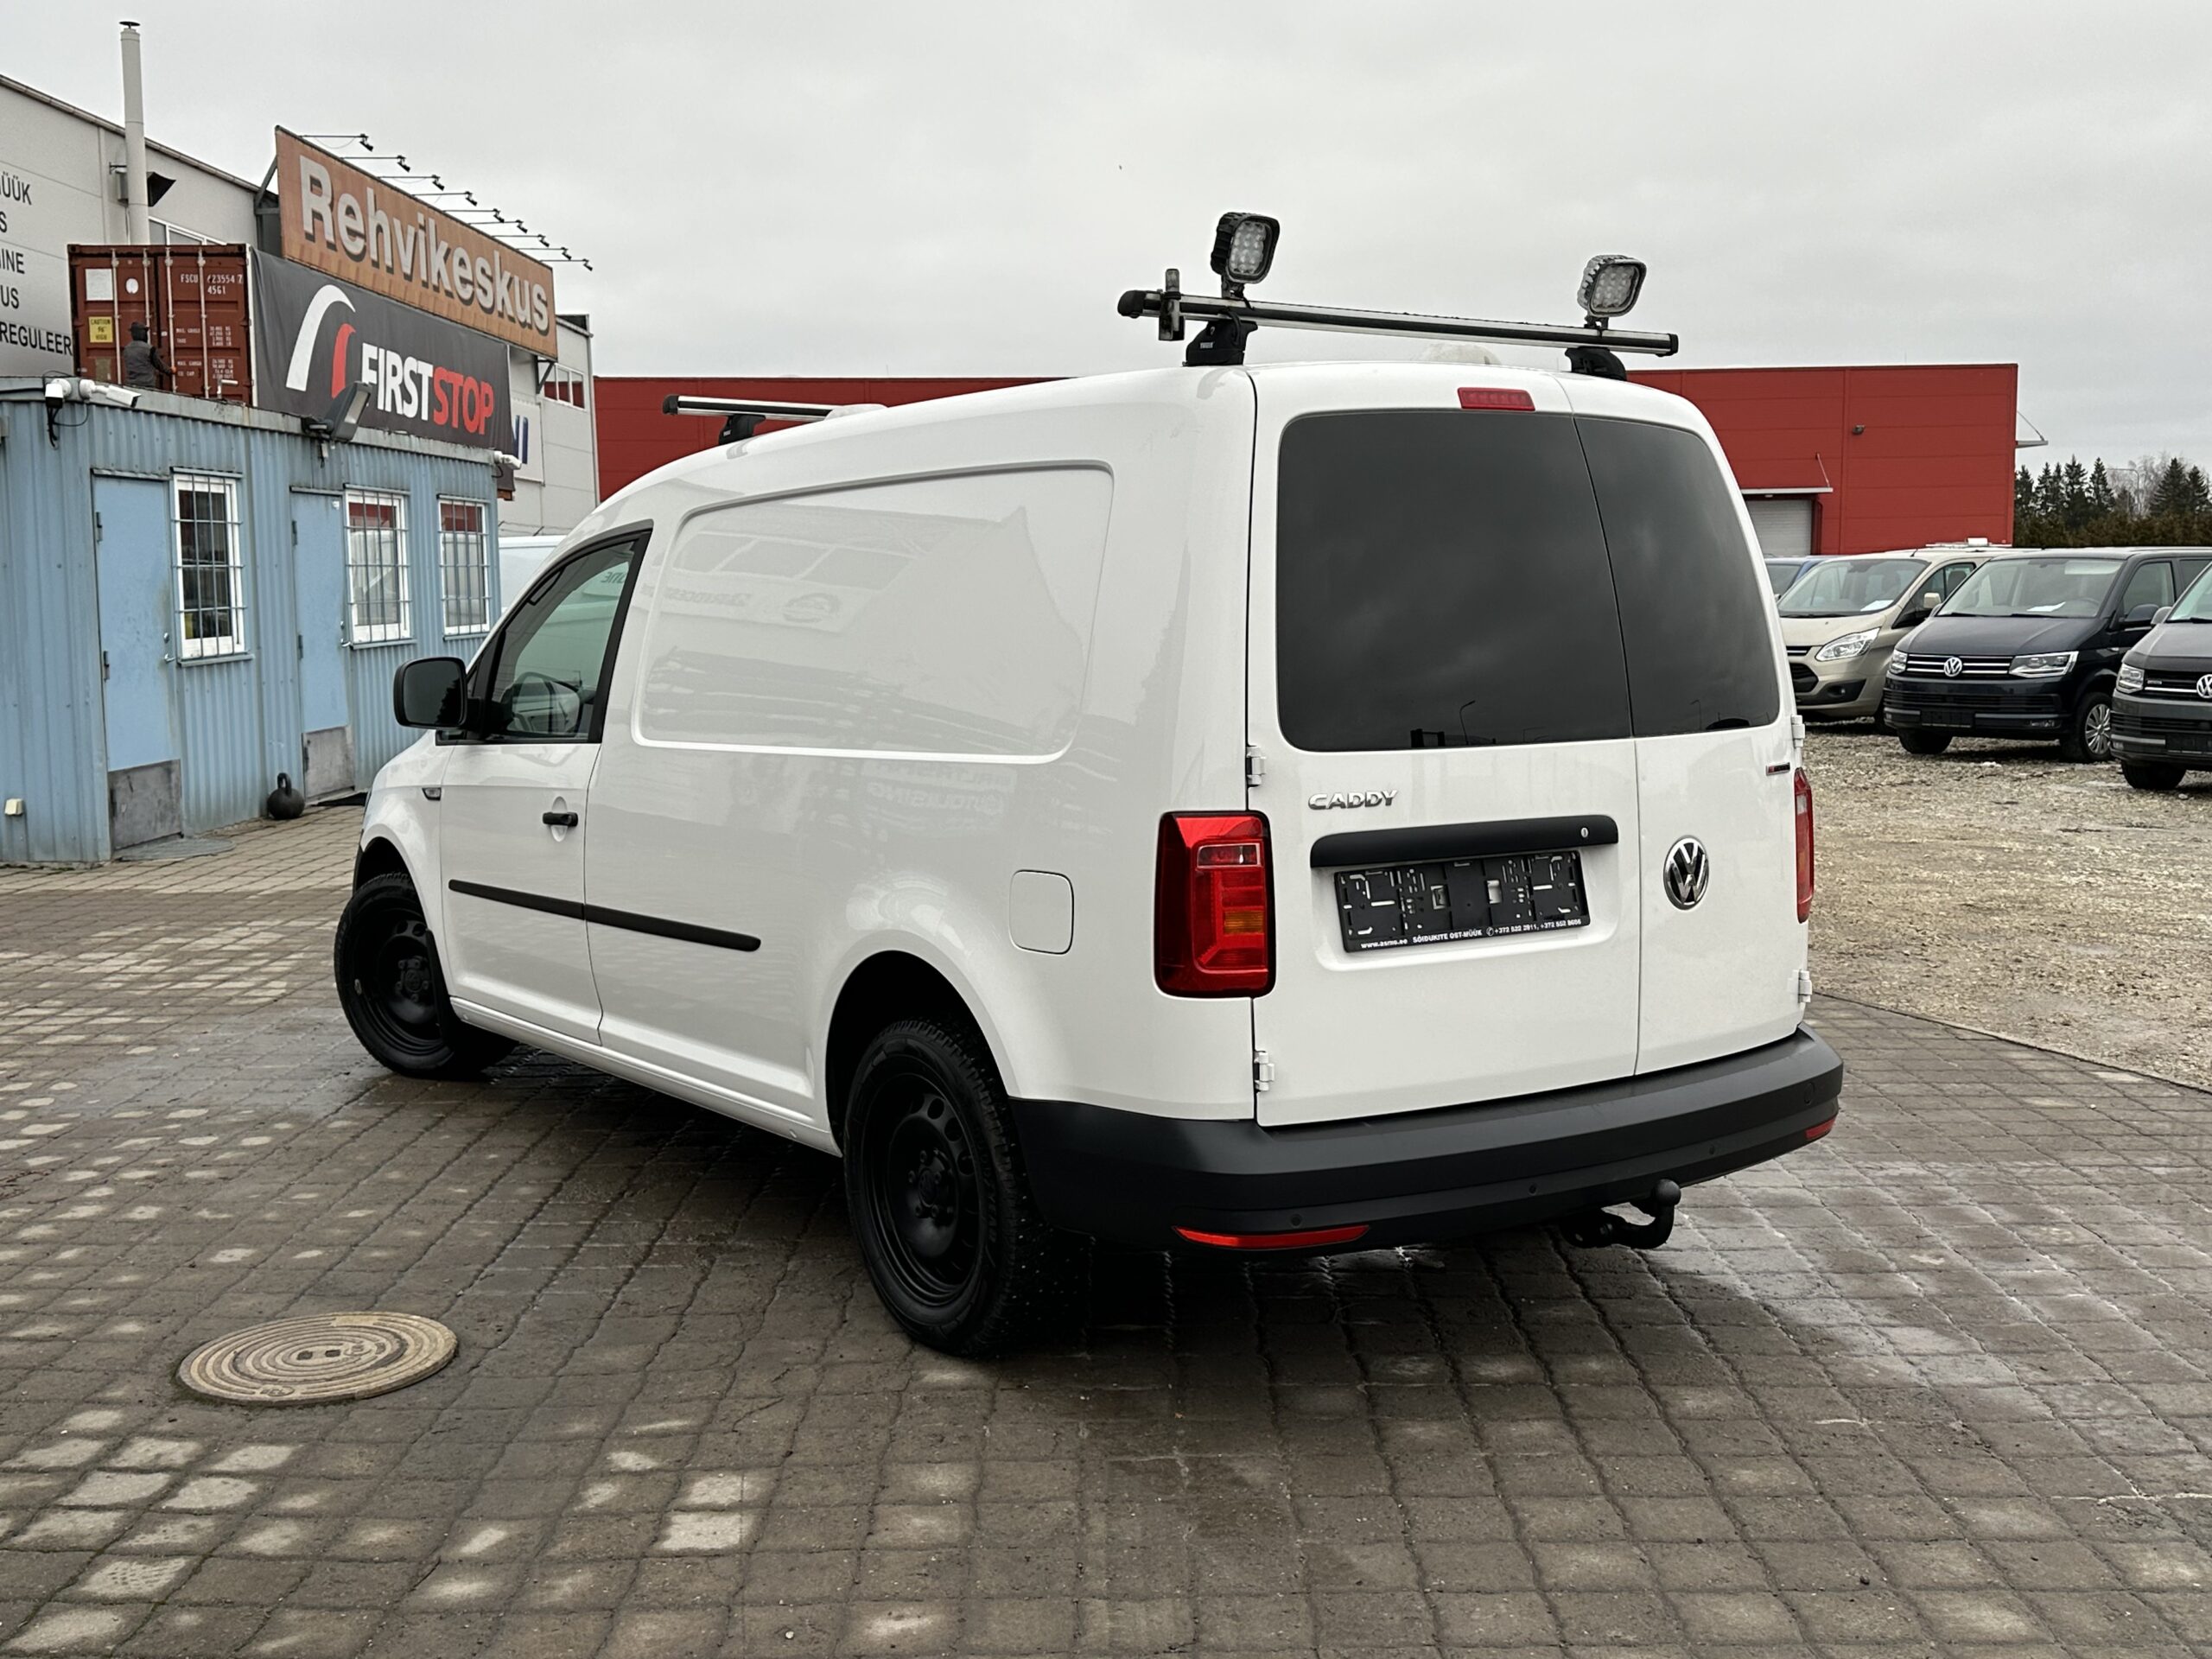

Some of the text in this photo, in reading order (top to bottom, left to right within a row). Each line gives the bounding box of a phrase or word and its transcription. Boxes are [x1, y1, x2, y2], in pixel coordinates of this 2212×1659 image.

[0, 170, 32, 206] ÜÜK
[299, 154, 550, 334] Rehvikeskus
[0, 248, 25, 275] INE
[180, 273, 199, 284] FSCU
[1307, 790, 1398, 810] CADDY
